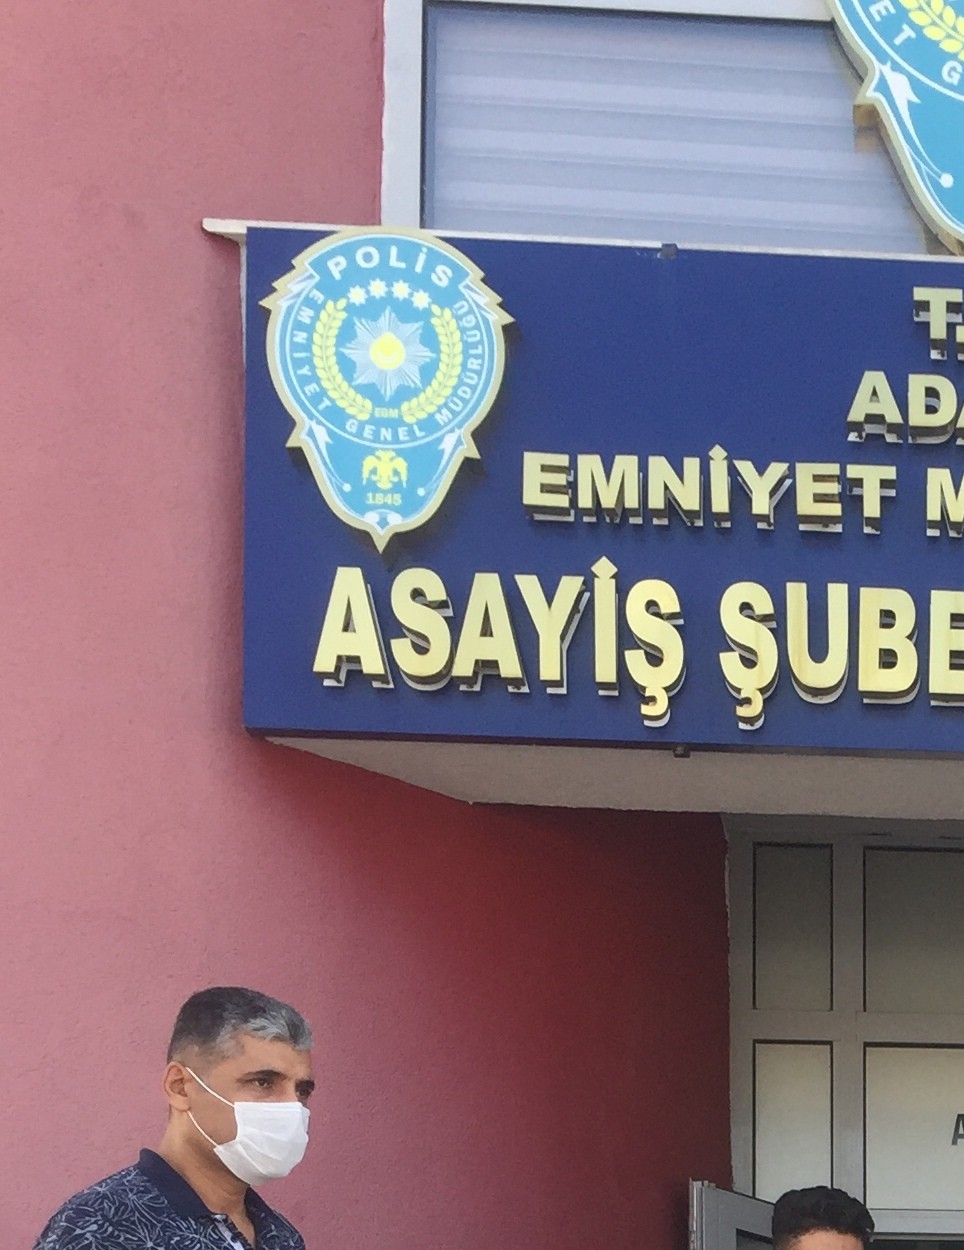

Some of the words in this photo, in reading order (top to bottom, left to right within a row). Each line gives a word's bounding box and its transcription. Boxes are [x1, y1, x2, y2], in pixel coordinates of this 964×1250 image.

[326, 245, 453, 288] POLİS
[292, 288, 332, 411] EMNİYET
[345, 419, 426, 441] GENEL
[366, 491, 402, 506] 1845
[523, 443, 897, 524] EMNİYET
[313, 555, 685, 720] ASAYİŞ
